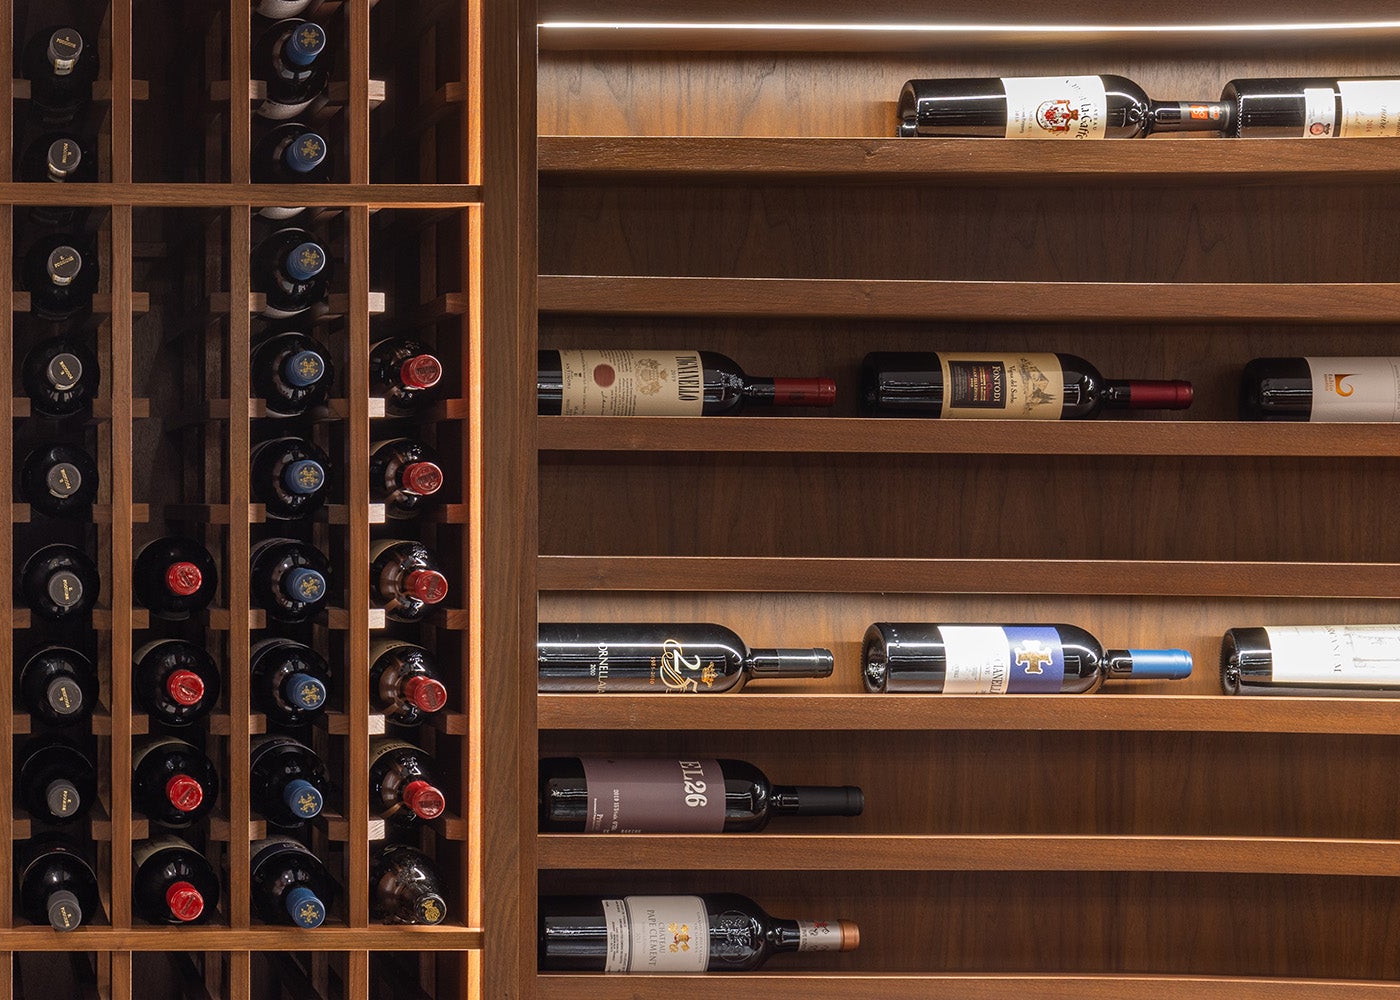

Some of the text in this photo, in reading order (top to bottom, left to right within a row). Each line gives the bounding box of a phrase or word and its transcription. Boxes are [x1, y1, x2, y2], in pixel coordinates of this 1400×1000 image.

[992, 366, 1002, 402] FONTODI
[680, 761, 707, 807] EL26
[647, 909, 659, 966] PAPE CLEMENT
[658, 922, 666, 955] CHATEAU
